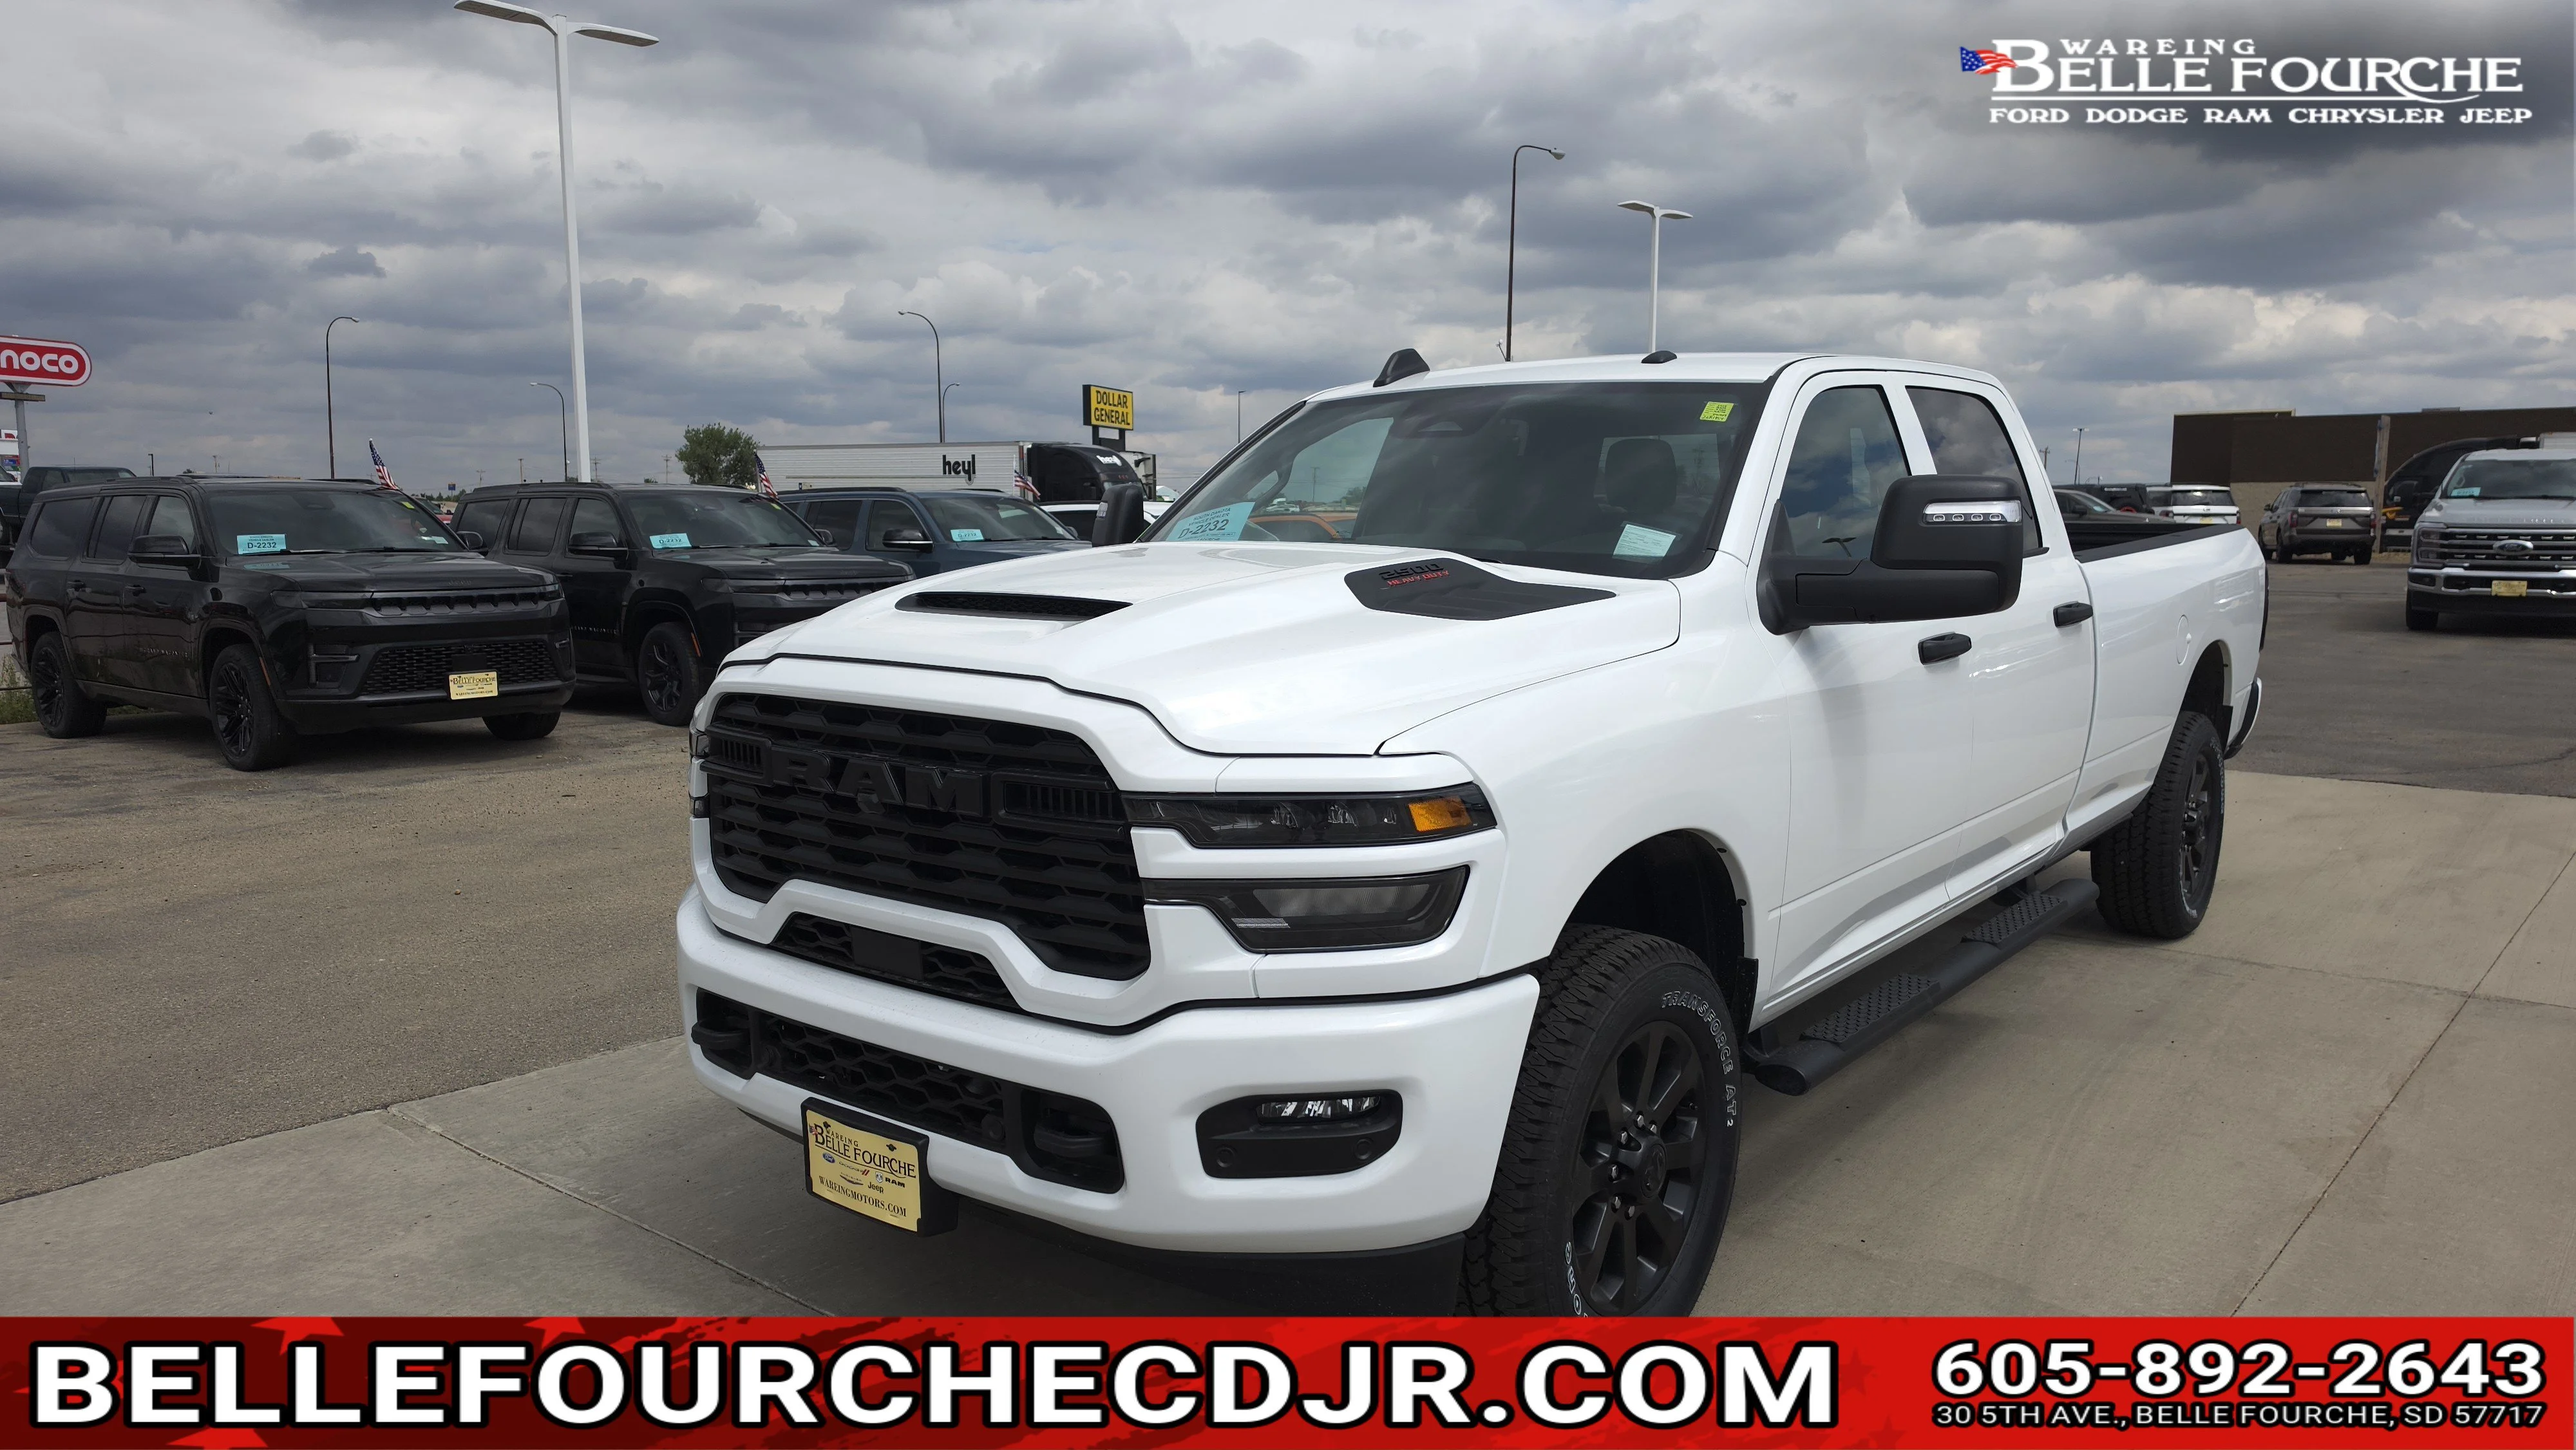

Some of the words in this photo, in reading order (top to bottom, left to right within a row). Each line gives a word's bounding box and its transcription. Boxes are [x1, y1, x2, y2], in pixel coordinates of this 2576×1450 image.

[1095, 390, 1128, 409] DOLLAR
[1094, 407, 1131, 426] GENERAL
[942, 454, 976, 482] heyl
[1178, 518, 1229, 539] D-2232
[1379, 564, 1444, 580] 2500
[1387, 575, 1421, 587] HEAVY
[1421, 570, 1449, 580] DUTY
[774, 746, 983, 817] RAM
[1662, 991, 1734, 1075] TRANSFORCE
[825, 1129, 859, 1147] WAREING
[813, 1123, 851, 1158] BELLE
[854, 1147, 916, 1178] FOURCHE
[867, 1182, 884, 1194] Jeep
[885, 1177, 905, 1188] RAM
[819, 1175, 907, 1218] WAREINGMOTORS.COM
